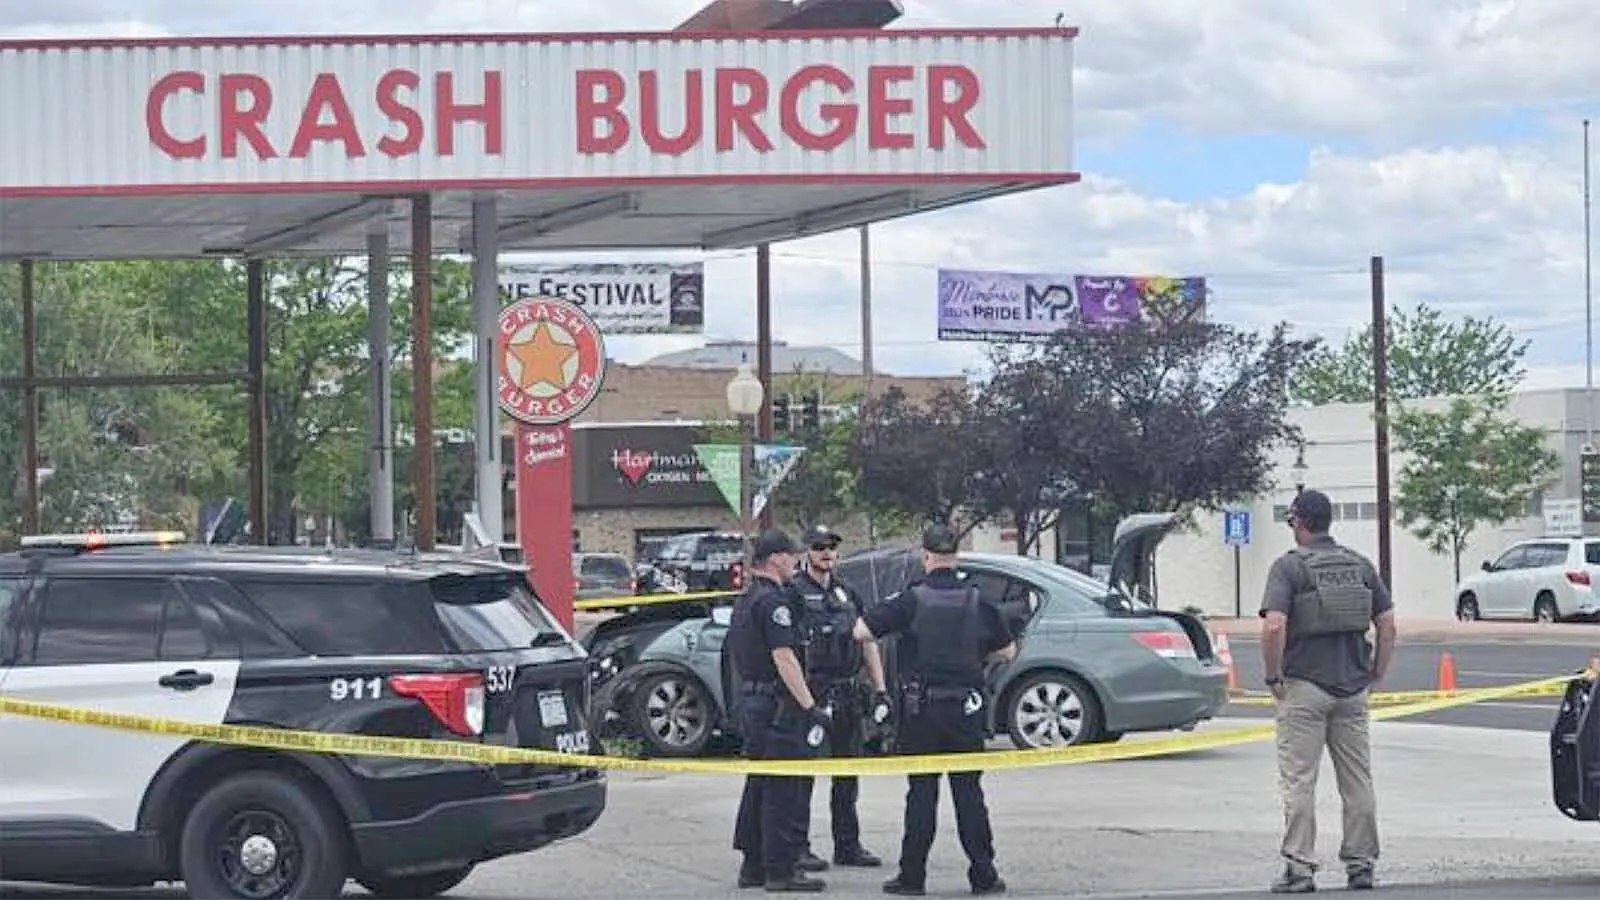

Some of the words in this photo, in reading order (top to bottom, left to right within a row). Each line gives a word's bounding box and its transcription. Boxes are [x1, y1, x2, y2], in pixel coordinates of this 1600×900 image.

[146, 68, 502, 160] CRASH
[575, 63, 986, 156] BURGER
[540, 277, 663, 306] FESTIVAL
[502, 303, 585, 334] CRASH
[973, 305, 1022, 320] PRIDE
[1318, 569, 1361, 586] POLICE
[330, 677, 382, 700] 911
[487, 664, 516, 692] 537
[556, 730, 590, 754] POLICE
